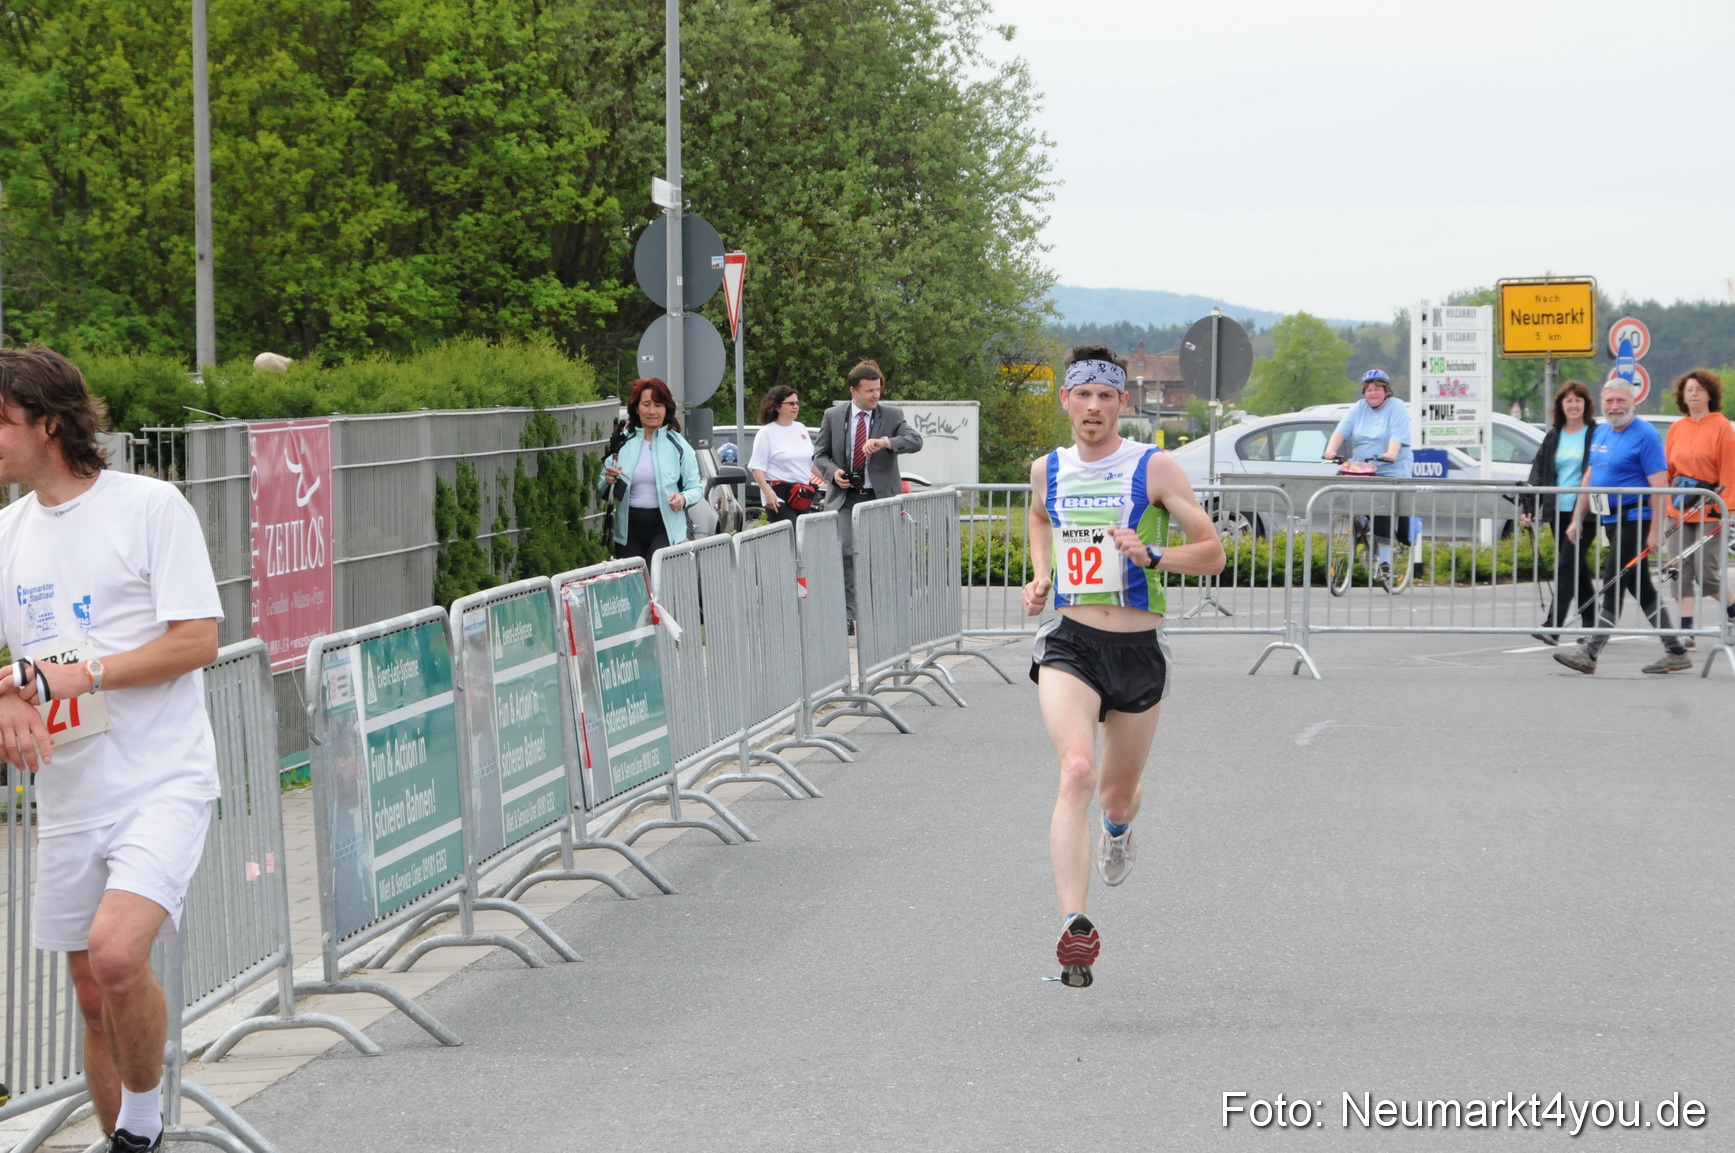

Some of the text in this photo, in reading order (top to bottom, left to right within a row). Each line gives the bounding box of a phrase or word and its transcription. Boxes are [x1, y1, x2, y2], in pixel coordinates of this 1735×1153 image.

[1535, 294, 1560, 303] Nach
[1446, 308, 1476, 318] HOLZAMMER
[1510, 307, 1585, 326] Neumarkt
[1446, 331, 1476, 341] HOLZAMMER
[1536, 332, 1562, 341] 5 km
[1429, 356, 1446, 374] SHB
[1429, 404, 1455, 420] THULE
[1413, 461, 1443, 476] OLVO
[1062, 495, 1124, 508] BOCK
[1062, 529, 1090, 538] MEYER
[265, 515, 325, 578] ZEITLOS
[1067, 546, 1103, 586] 92
[22, 583, 55, 596] Neumarkter
[29, 590, 55, 603] Stadtlauf
[599, 650, 640, 691] Fun & Action in
[498, 682, 539, 729] Fun & Action in
[606, 691, 649, 735] sicheren Bahnen!
[370, 727, 427, 784] Fun & Action in
[501, 728, 547, 778] sicheren Bahnen!
[374, 778, 436, 840] sicheren Bahnen!
